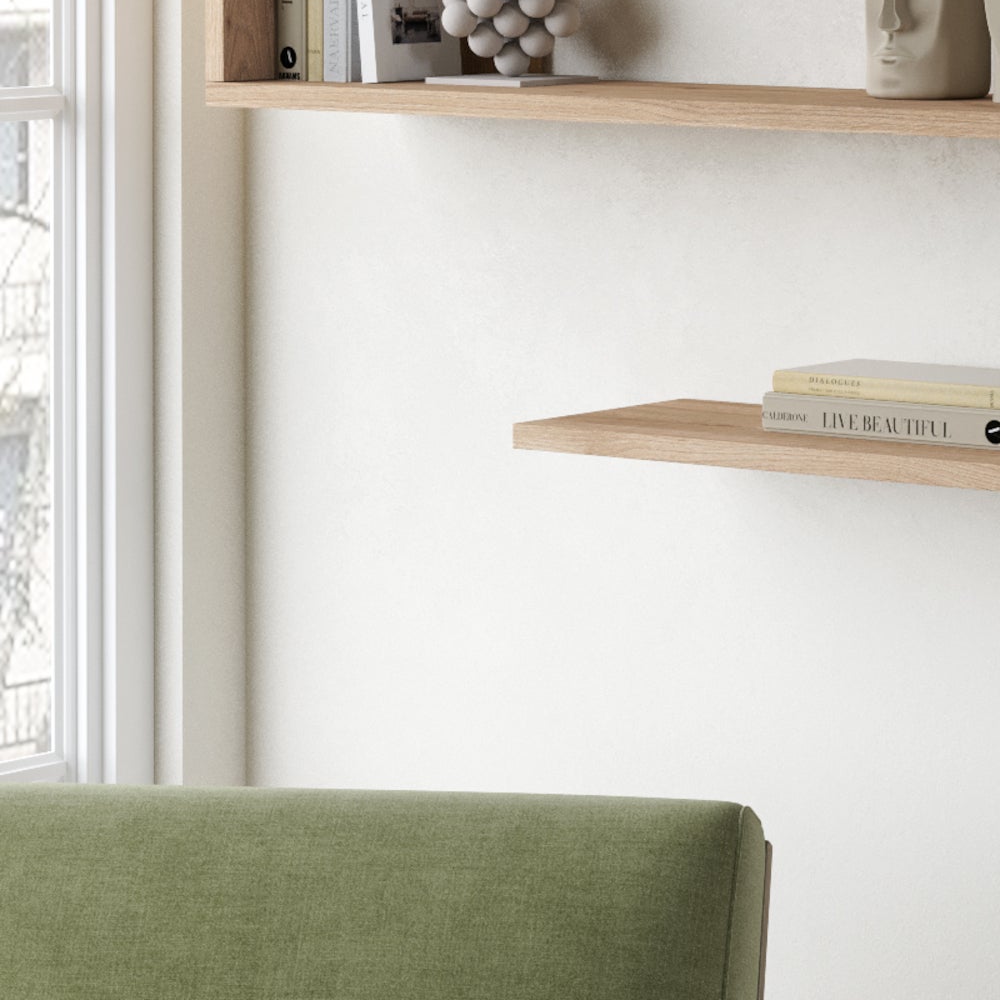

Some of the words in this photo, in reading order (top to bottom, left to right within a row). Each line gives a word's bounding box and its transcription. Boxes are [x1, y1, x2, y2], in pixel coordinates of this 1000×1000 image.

[808, 376, 861, 387] DIALOGUES
[762, 411, 808, 423] CALDERONE
[823, 412, 858, 431] LIVE
[863, 414, 952, 438] BEAUTIFUL
